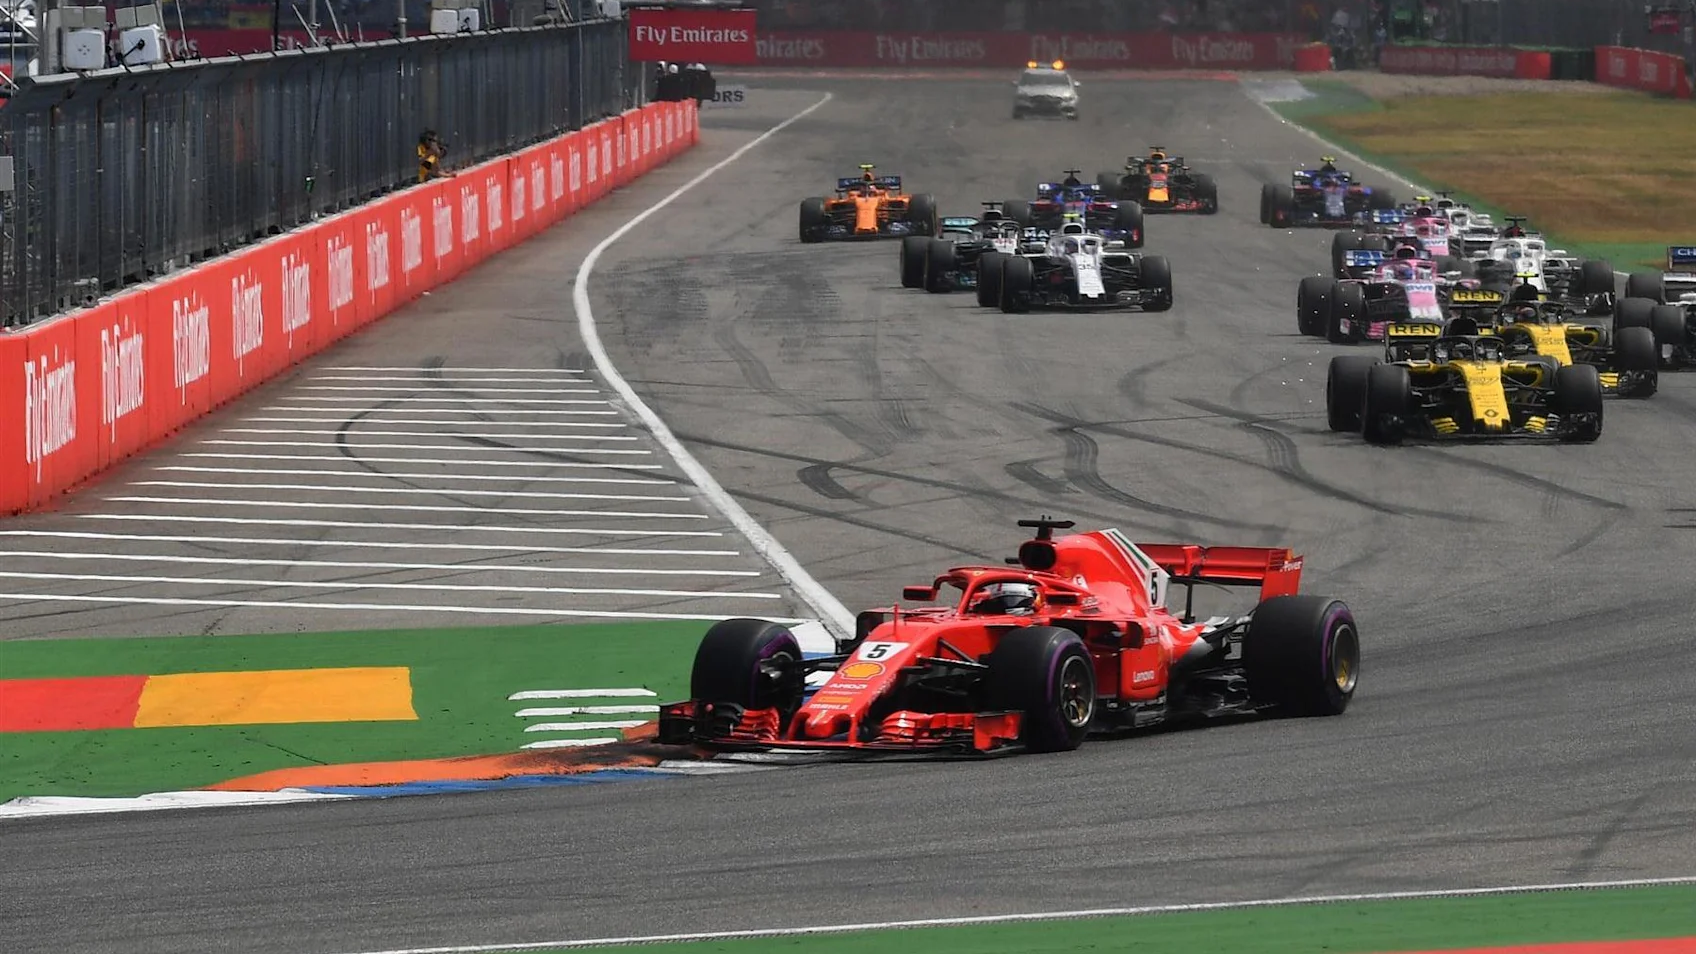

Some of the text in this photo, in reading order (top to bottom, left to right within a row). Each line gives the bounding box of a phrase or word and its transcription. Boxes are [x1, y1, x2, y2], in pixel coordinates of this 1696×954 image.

[636, 26, 748, 45] Fly Emirates
[877, 36, 906, 64] Fly
[1151, 571, 1159, 605] 5
[866, 644, 891, 659] 5
[1132, 670, 1155, 684] Lenovo
